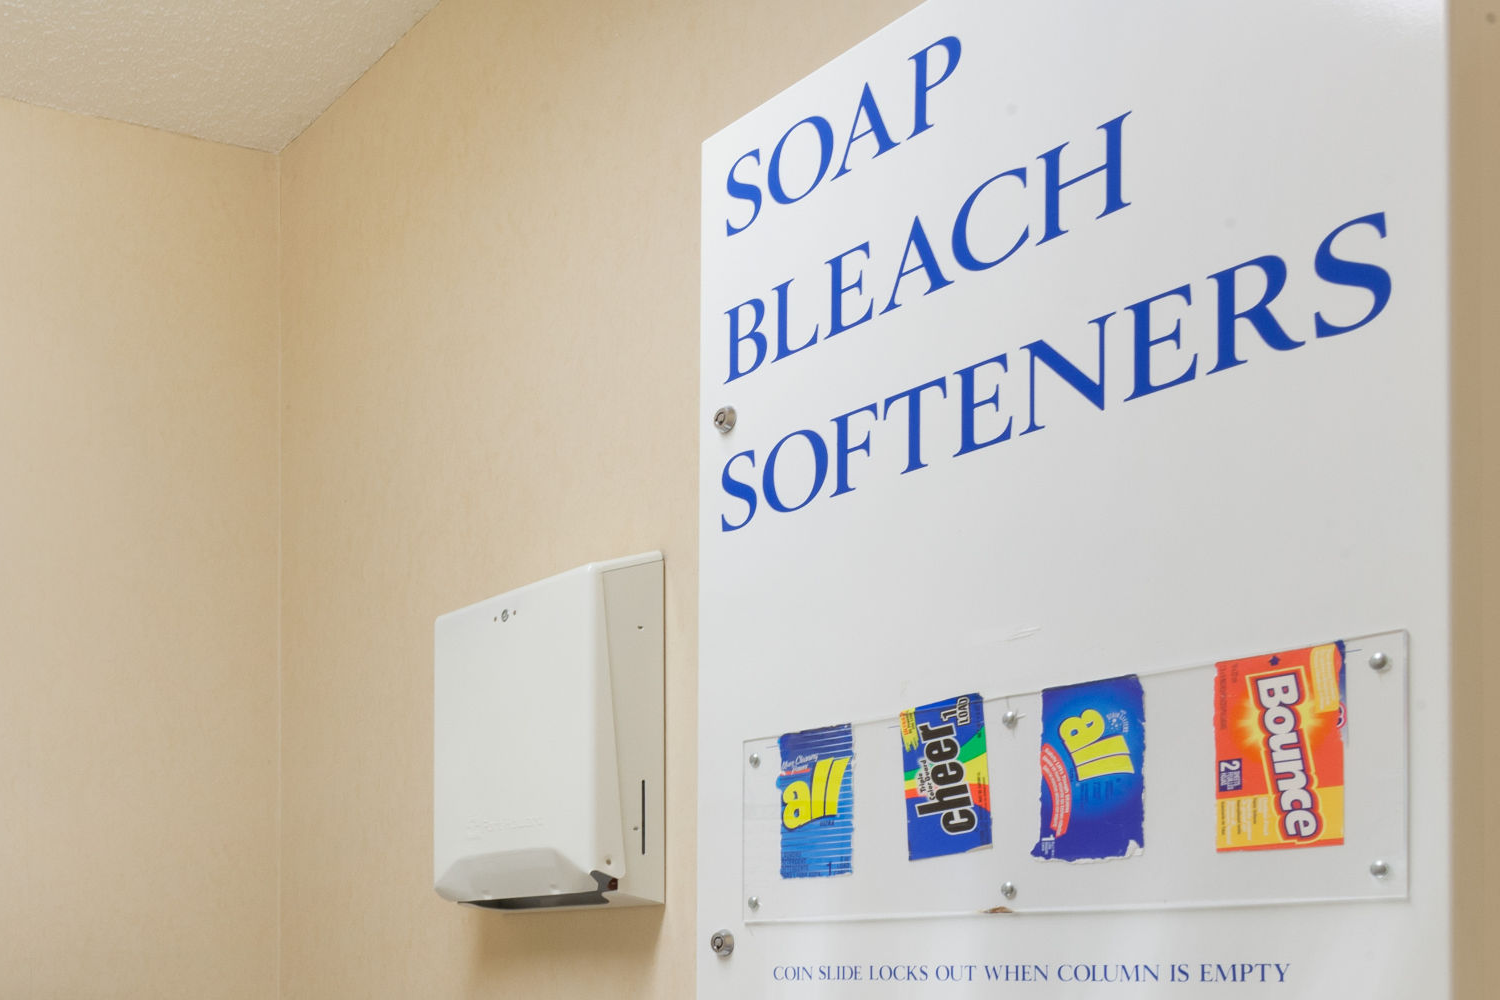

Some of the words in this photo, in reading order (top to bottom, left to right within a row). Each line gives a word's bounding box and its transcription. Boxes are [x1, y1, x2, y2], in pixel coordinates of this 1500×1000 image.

[725, 35, 962, 237] SOAP
[723, 110, 1132, 385] BLEACH
[720, 211, 1392, 532] SOFTENERS
[940, 707, 958, 722] 1
[957, 697, 970, 725] LOAD
[1059, 708, 1135, 782] all
[1219, 760, 1240, 772] 2
[1256, 672, 1318, 838] Bounce
[782, 757, 850, 830] all
[916, 722, 977, 835] cheer
[918, 772, 926, 794] Triple
[920, 760, 931, 781] Guard
[927, 780, 936, 800] Color
[773, 965, 813, 981] COIN
[818, 965, 863, 981] SLIDE
[869, 964, 929, 982] LOCKS
[935, 964, 977, 982] OUT
[985, 964, 1048, 982] WHEN
[1057, 964, 1160, 982] COLUMN
[1170, 964, 1189, 982] IS
[1200, 964, 1290, 982] EMPTY
